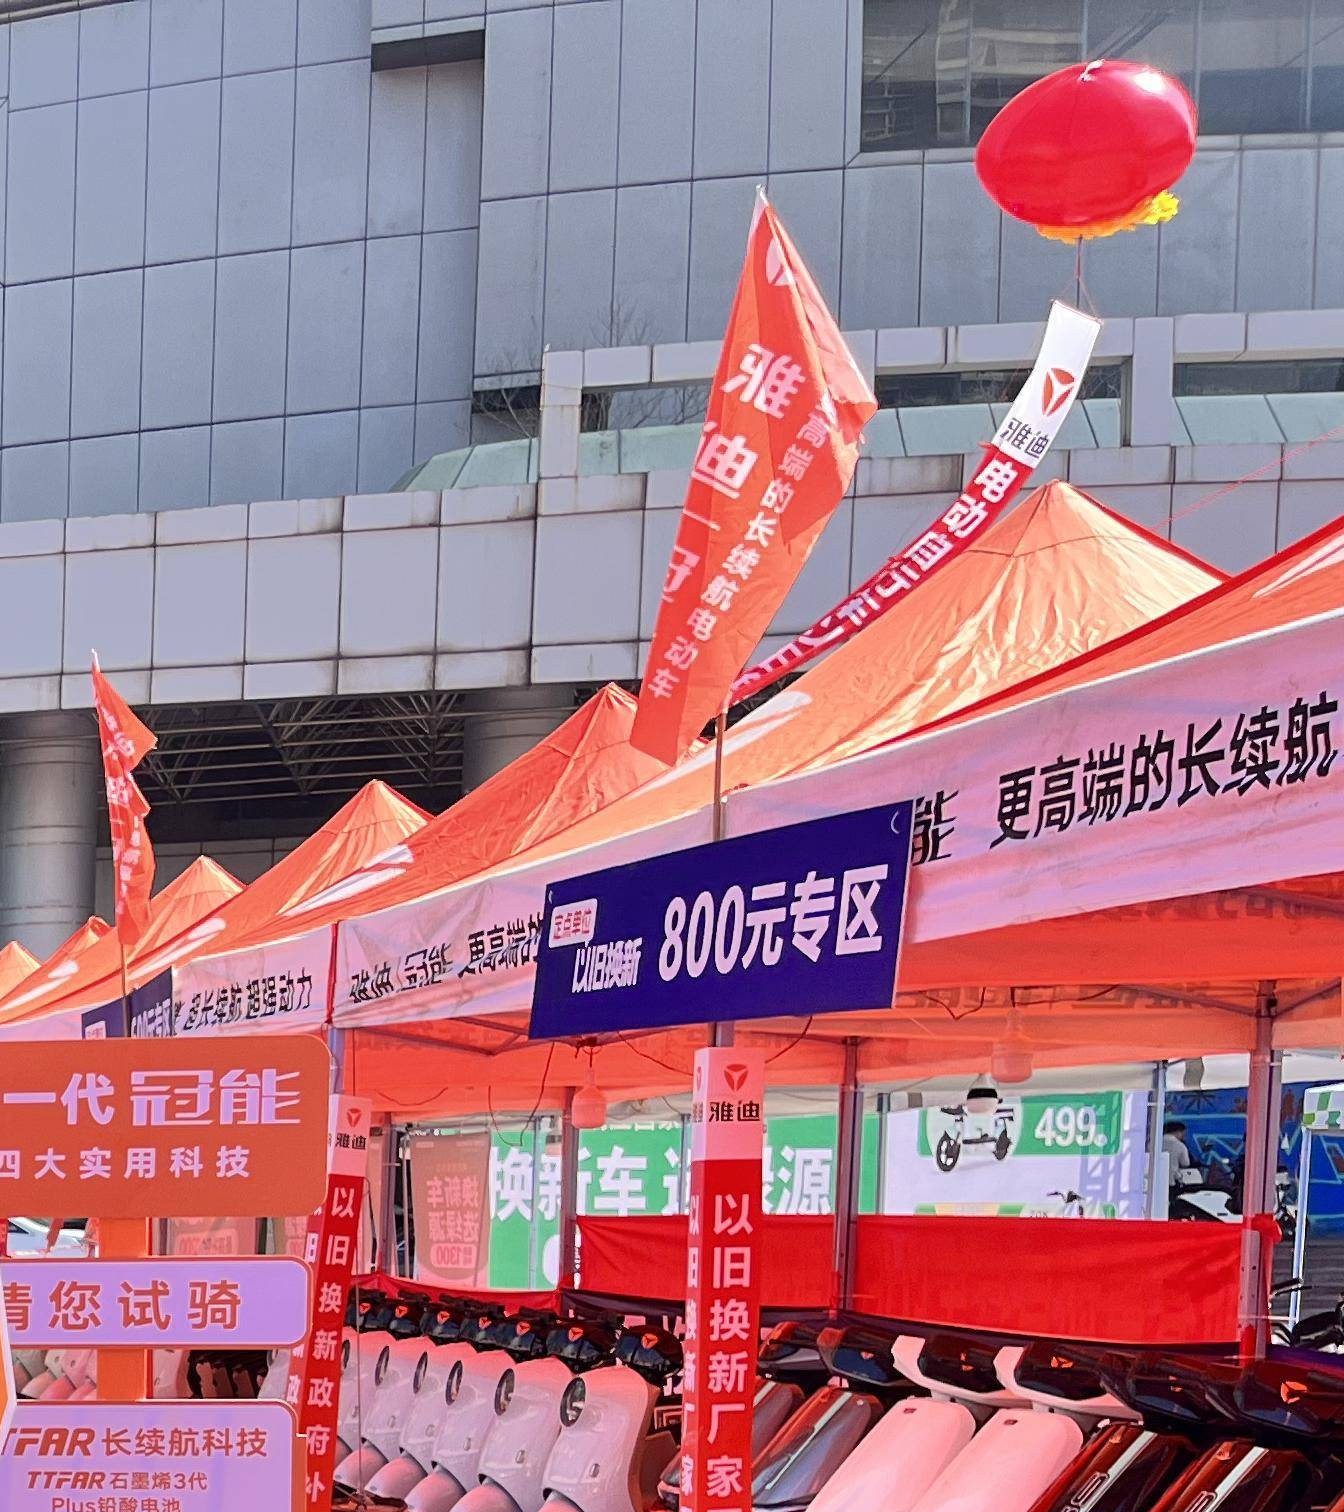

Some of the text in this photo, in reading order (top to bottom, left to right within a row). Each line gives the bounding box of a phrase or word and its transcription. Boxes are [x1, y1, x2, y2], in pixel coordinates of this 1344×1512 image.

[1000, 418, 1049, 459] 雅迪
[658, 864, 889, 982] 800元专区
[572, 937, 643, 993] 以旧换新
[131, 1068, 301, 1128] 冠能
[709, 1101, 760, 1122] 雅迪
[336, 1133, 367, 1150] 雅迪
[102, 1427, 268, 1459] 长续航科技
[108, 1471, 208, 1491] 石墨烯3代
